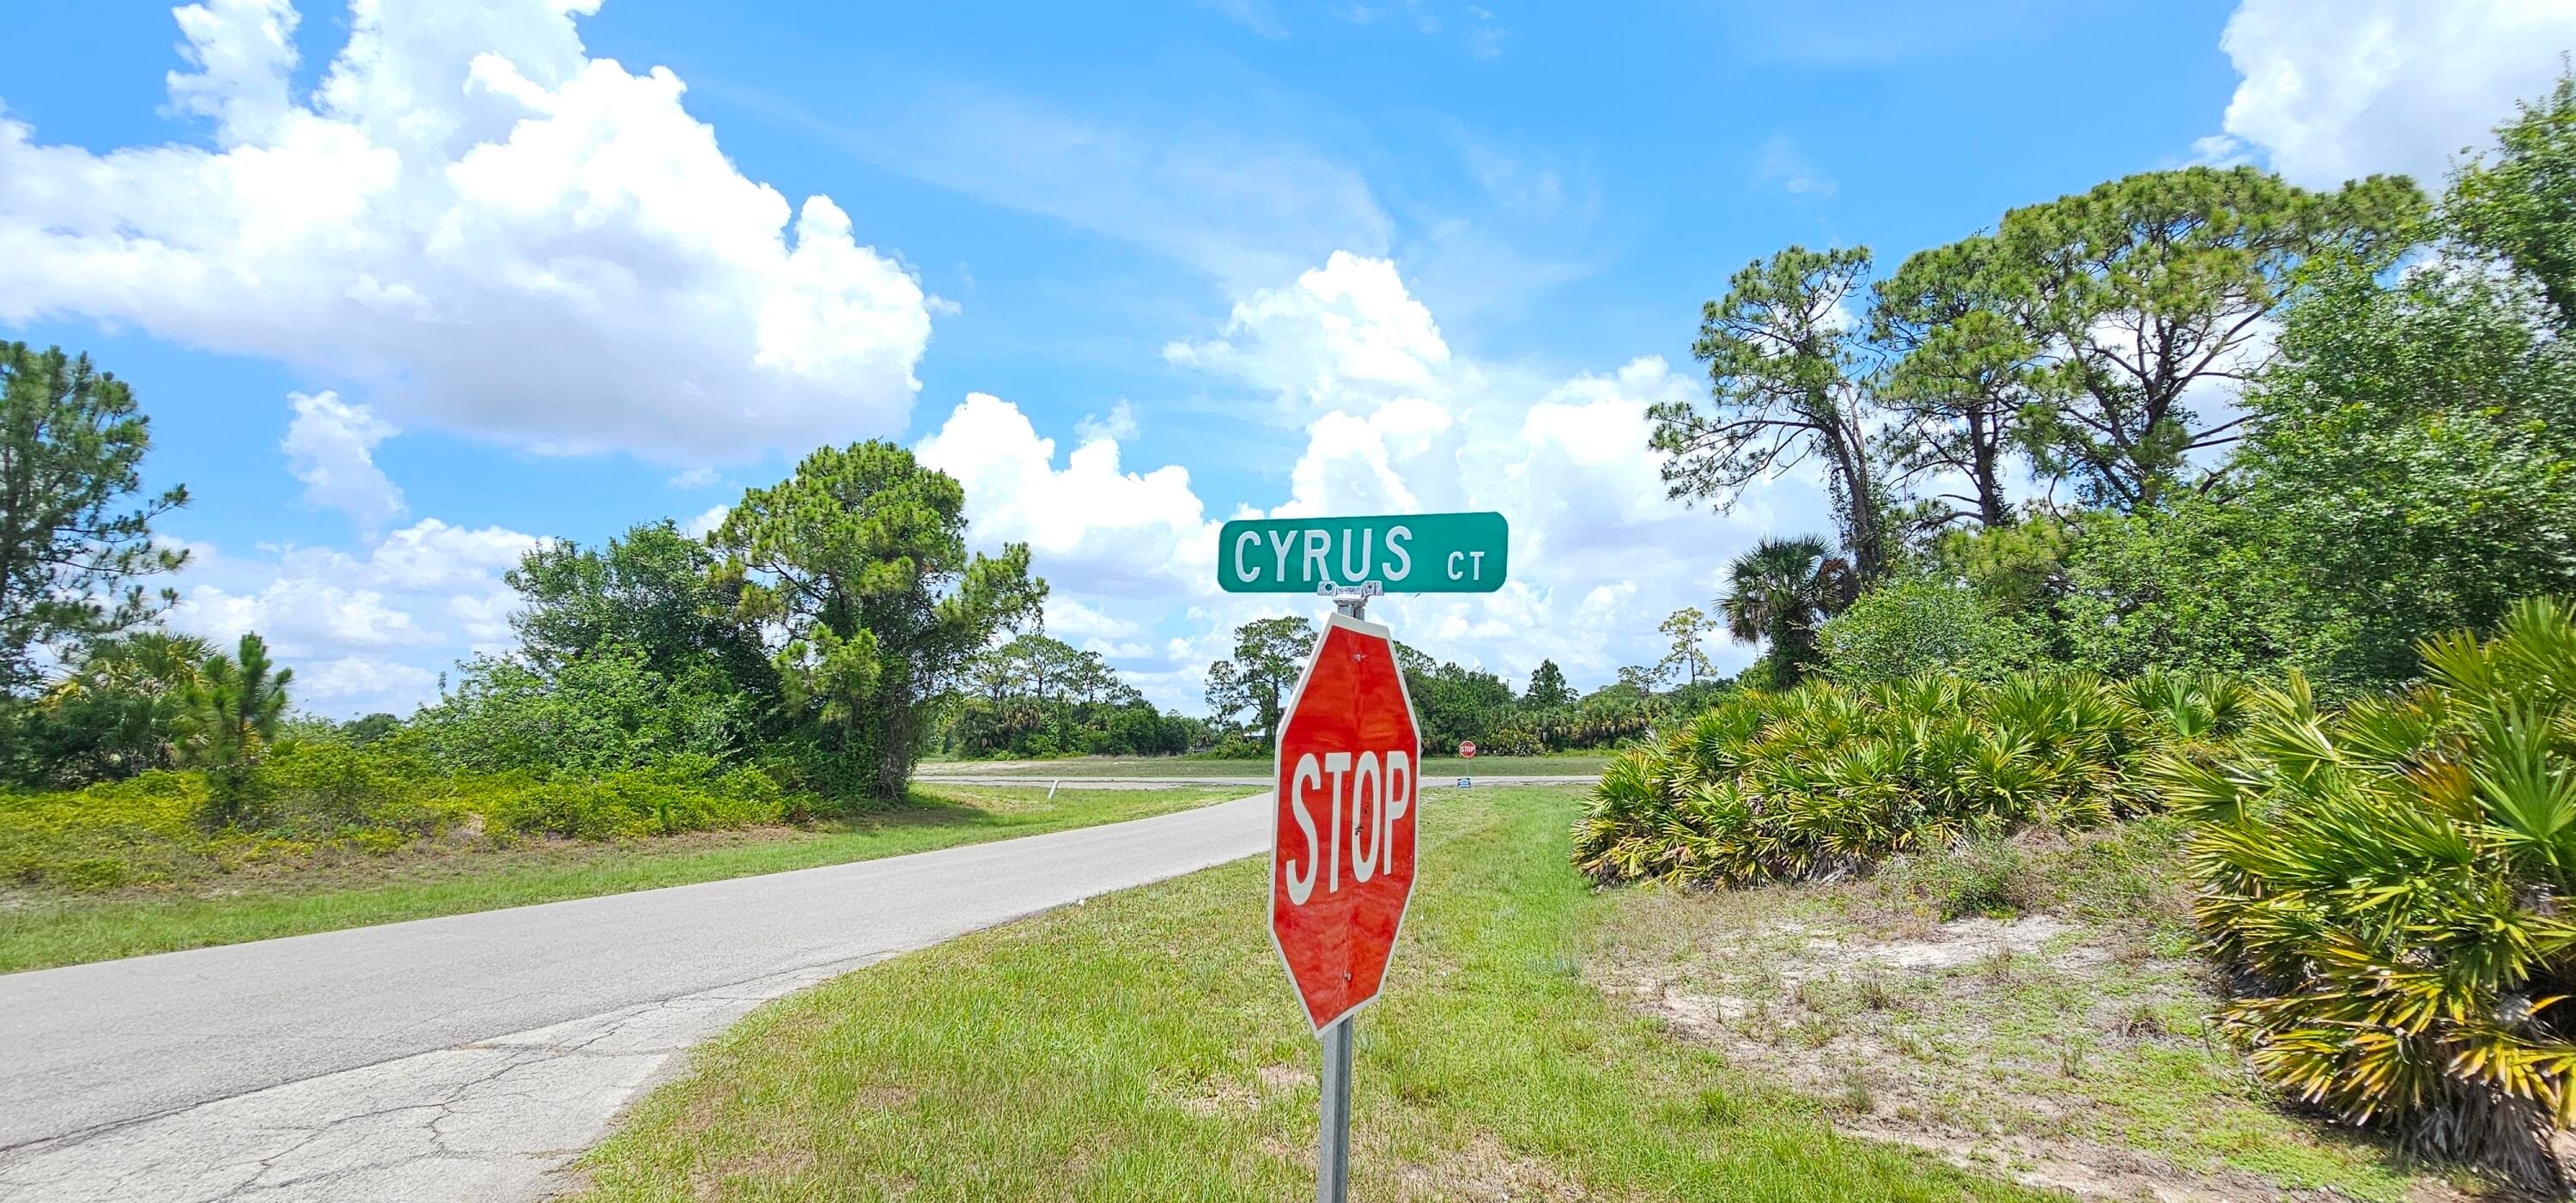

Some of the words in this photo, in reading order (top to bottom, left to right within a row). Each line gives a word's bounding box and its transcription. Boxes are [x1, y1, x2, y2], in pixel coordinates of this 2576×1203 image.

[1235, 525, 1413, 583] CYRUS
[1447, 550, 1485, 580] CT
[1286, 750, 1411, 906] STOP
